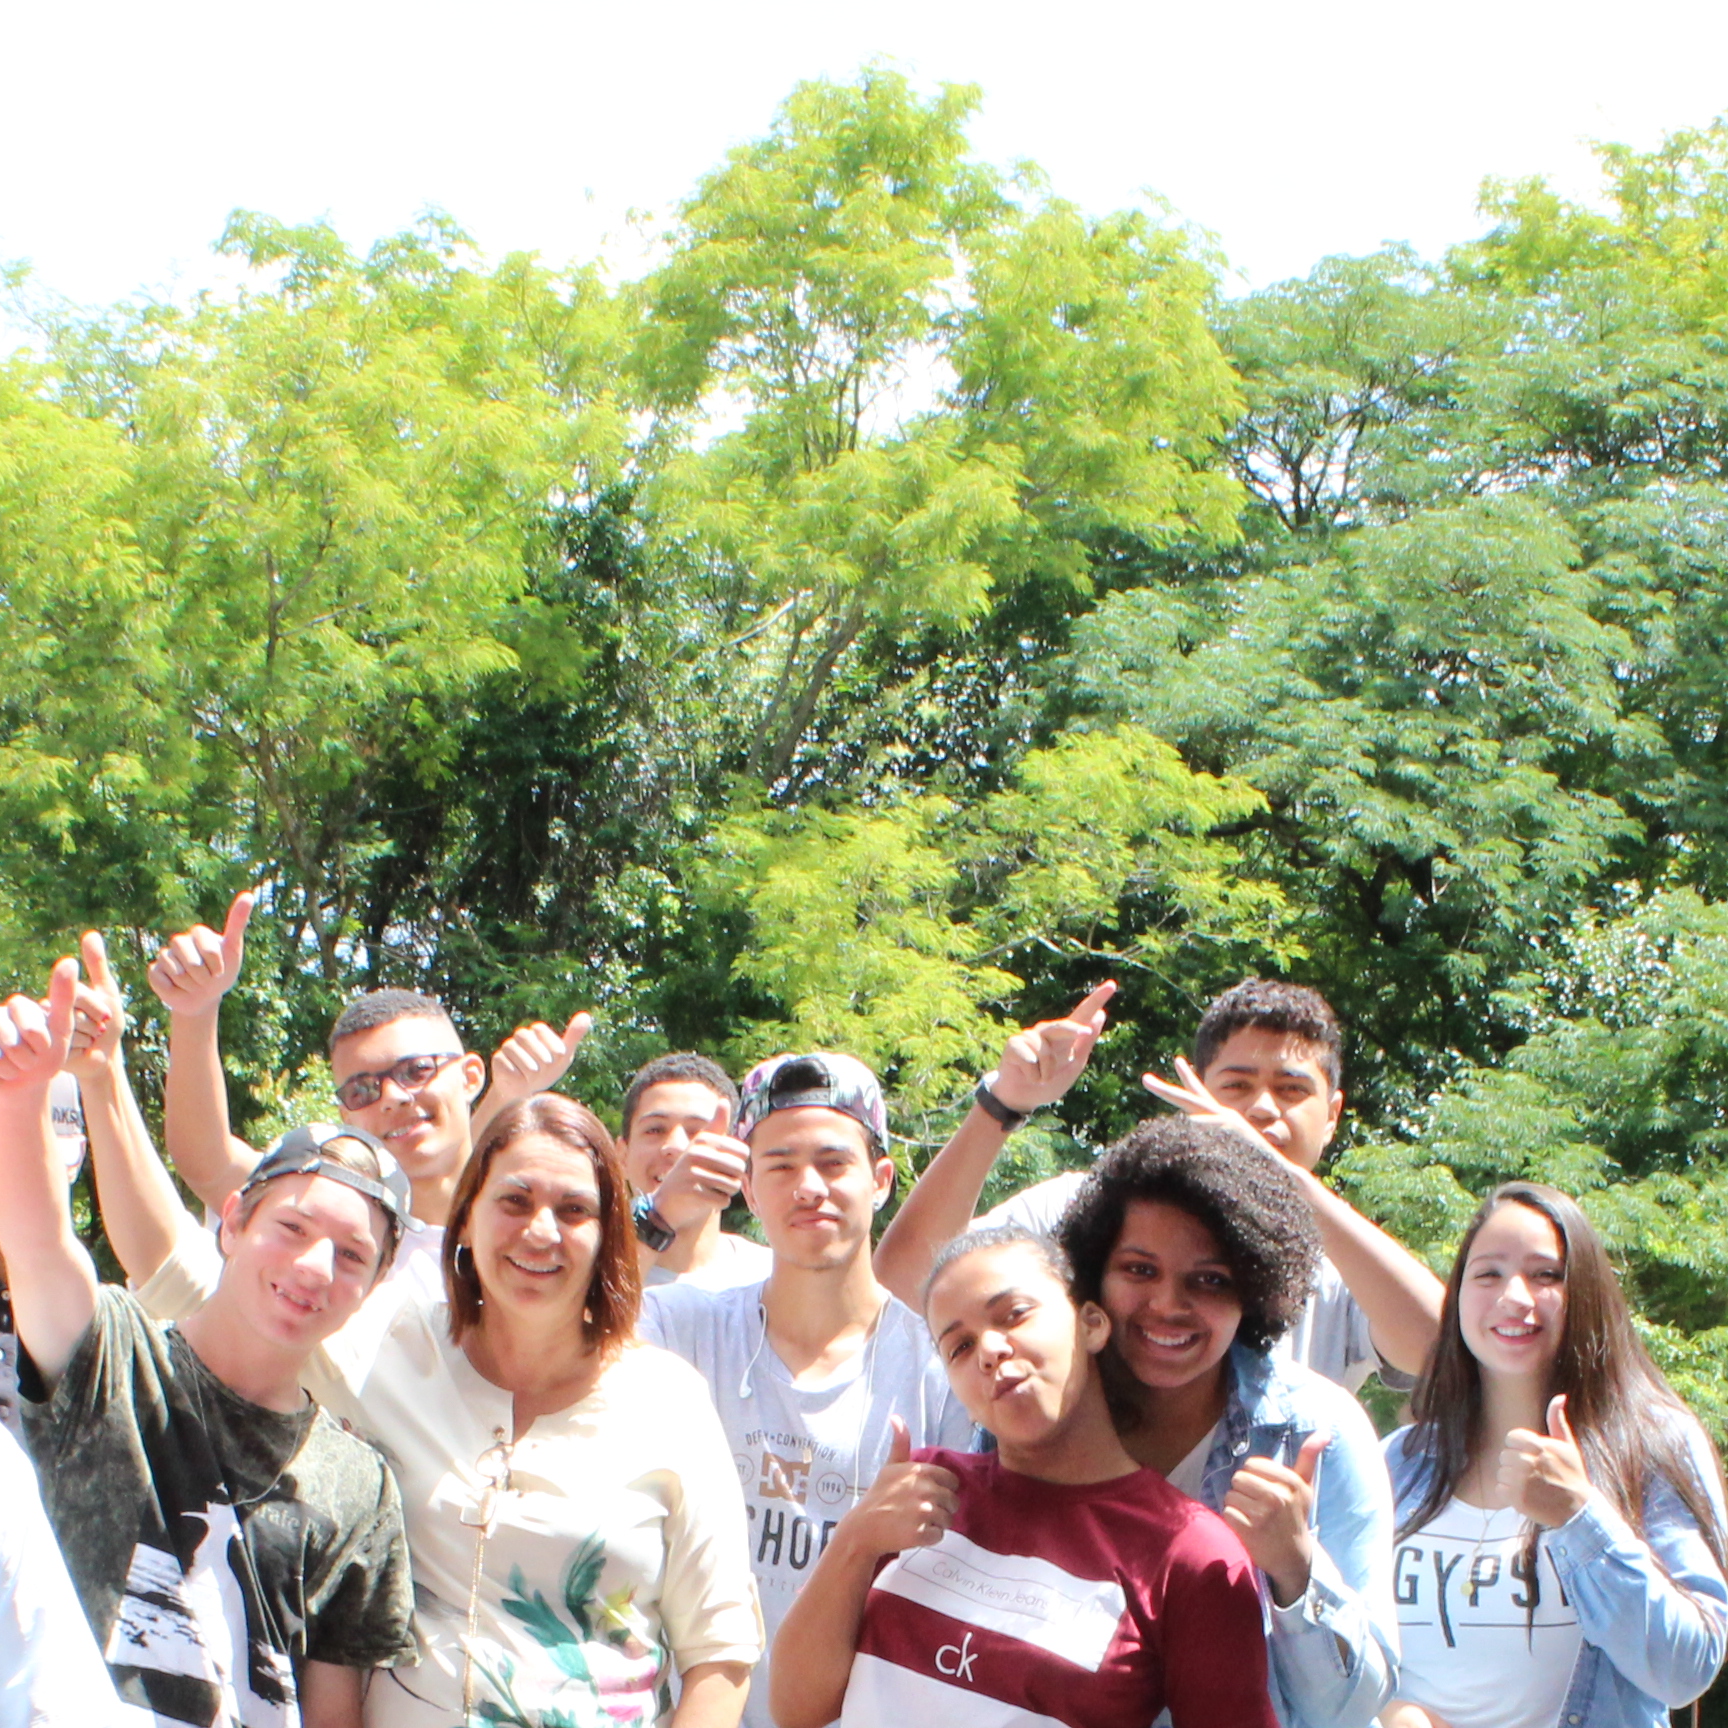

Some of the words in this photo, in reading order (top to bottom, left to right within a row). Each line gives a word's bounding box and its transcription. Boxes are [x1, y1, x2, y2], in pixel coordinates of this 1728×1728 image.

[745, 1429, 769, 1446] DEFY
[821, 1481, 841, 1494] 1994
[931, 1560, 975, 1591] Calvin
[975, 1582, 1010, 1601] Klein
[934, 1631, 979, 1682] ck
